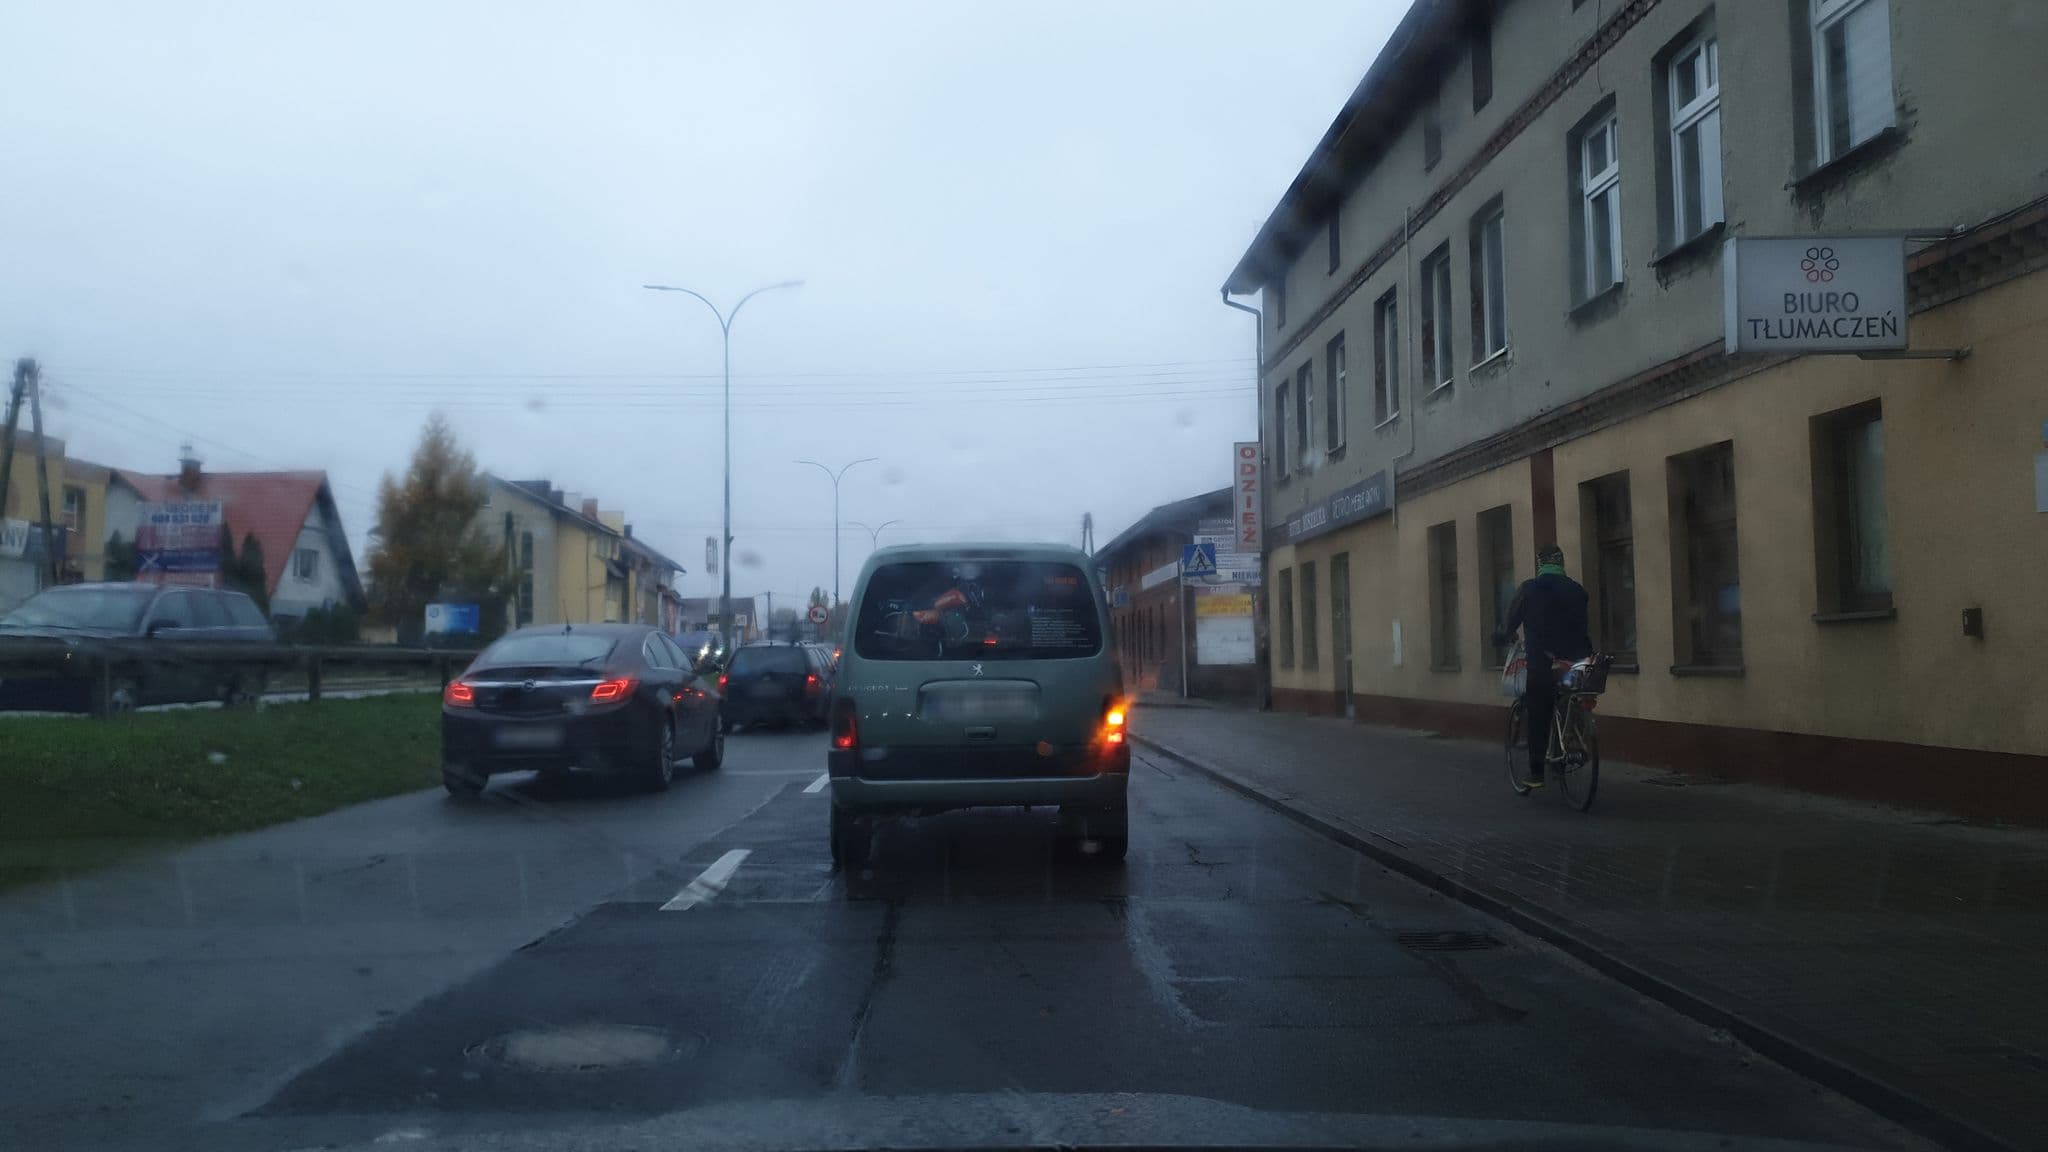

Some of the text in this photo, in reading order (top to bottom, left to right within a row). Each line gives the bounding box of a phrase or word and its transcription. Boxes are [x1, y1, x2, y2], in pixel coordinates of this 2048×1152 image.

[1784, 292, 1859, 314] BIURO
[1747, 310, 1898, 340] TŁUMACZEŃ
[1239, 446, 1257, 543] ODZIEŻ
